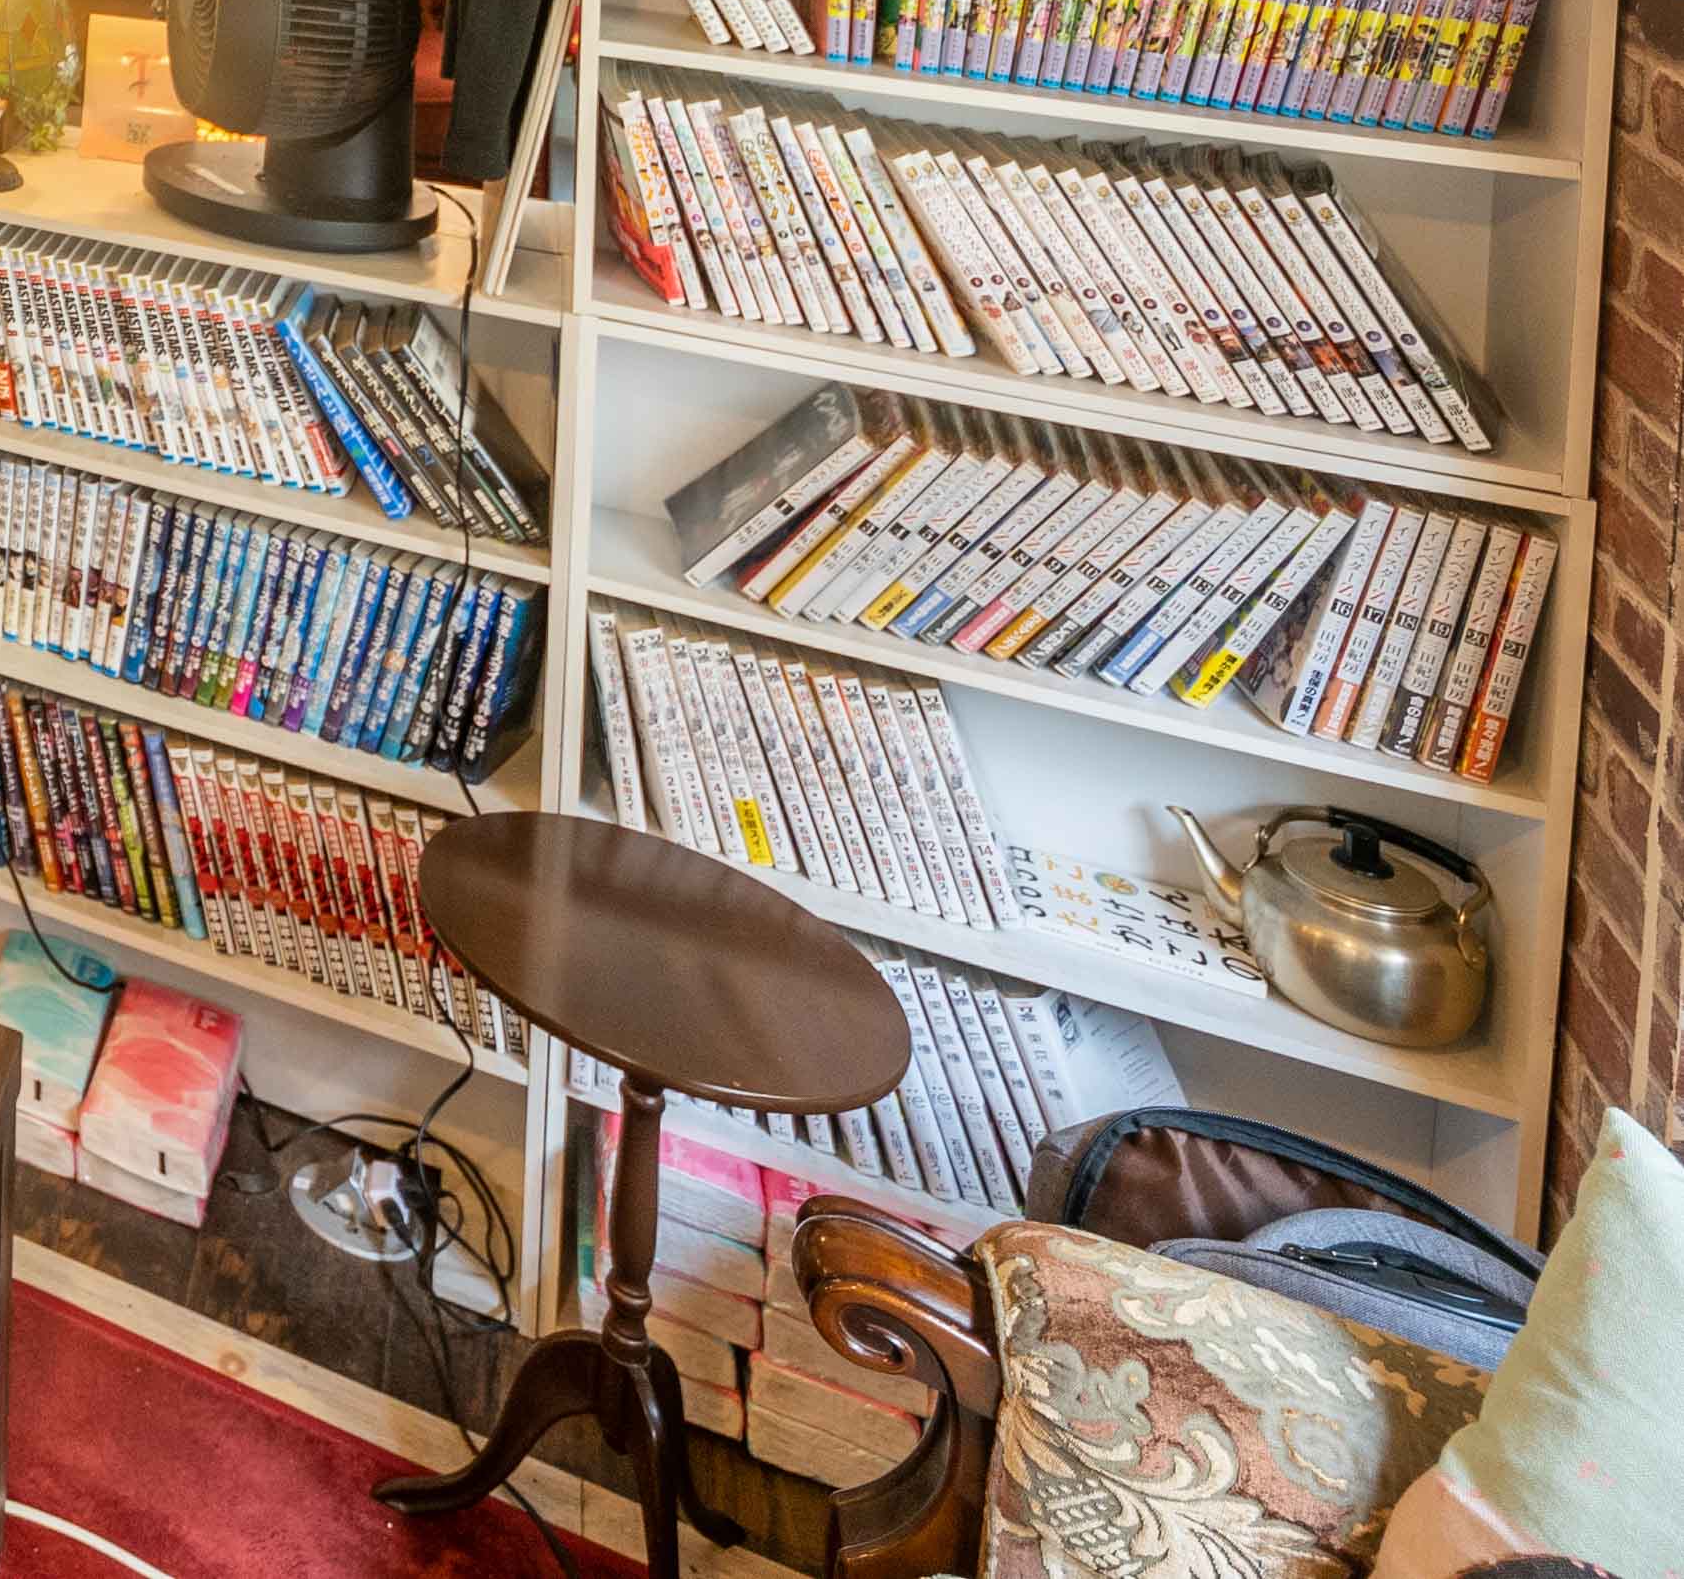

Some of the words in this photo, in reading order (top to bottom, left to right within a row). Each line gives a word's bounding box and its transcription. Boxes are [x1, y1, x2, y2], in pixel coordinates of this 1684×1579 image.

[1483, 8, 1500, 24] 25
[1513, 11, 1530, 26] 26
[14, 270, 33, 325] BEASTARS
[45, 278, 67, 333] BEASTARS
[61, 282, 84, 339] BEASTARS
[76, 285, 98, 343] BEASTARS
[93, 289, 117, 345] BEASTARS
[142, 299, 167, 357] BEASTARS
[159, 304, 185, 362] BEASTARS
[178, 308, 202, 366] BEASTARS
[211, 312, 239, 371] BEASTARS
[1366, 526, 1409, 602] インベスターZ
[1401, 531, 1439, 611] インベスターZ
[1434, 535, 1470, 619] インベスターZ
[1470, 543, 1507, 626] インベスターZ
[1507, 555, 1545, 638] インベスターZ
[665, 776, 674, 786] 2
[687, 773, 695, 783] 3
[713, 783, 721, 792] 4
[737, 787, 745, 797] 5
[760, 793, 769, 803] 6
[791, 804, 800, 815] 8
[816, 810, 825, 821] 7
[842, 815, 851, 826] 9
[868, 826, 884, 837] 10
[894, 832, 909, 843] 11
[920, 840, 937, 852] 12
[949, 847, 965, 858] 13
[978, 845, 993, 856] 14
